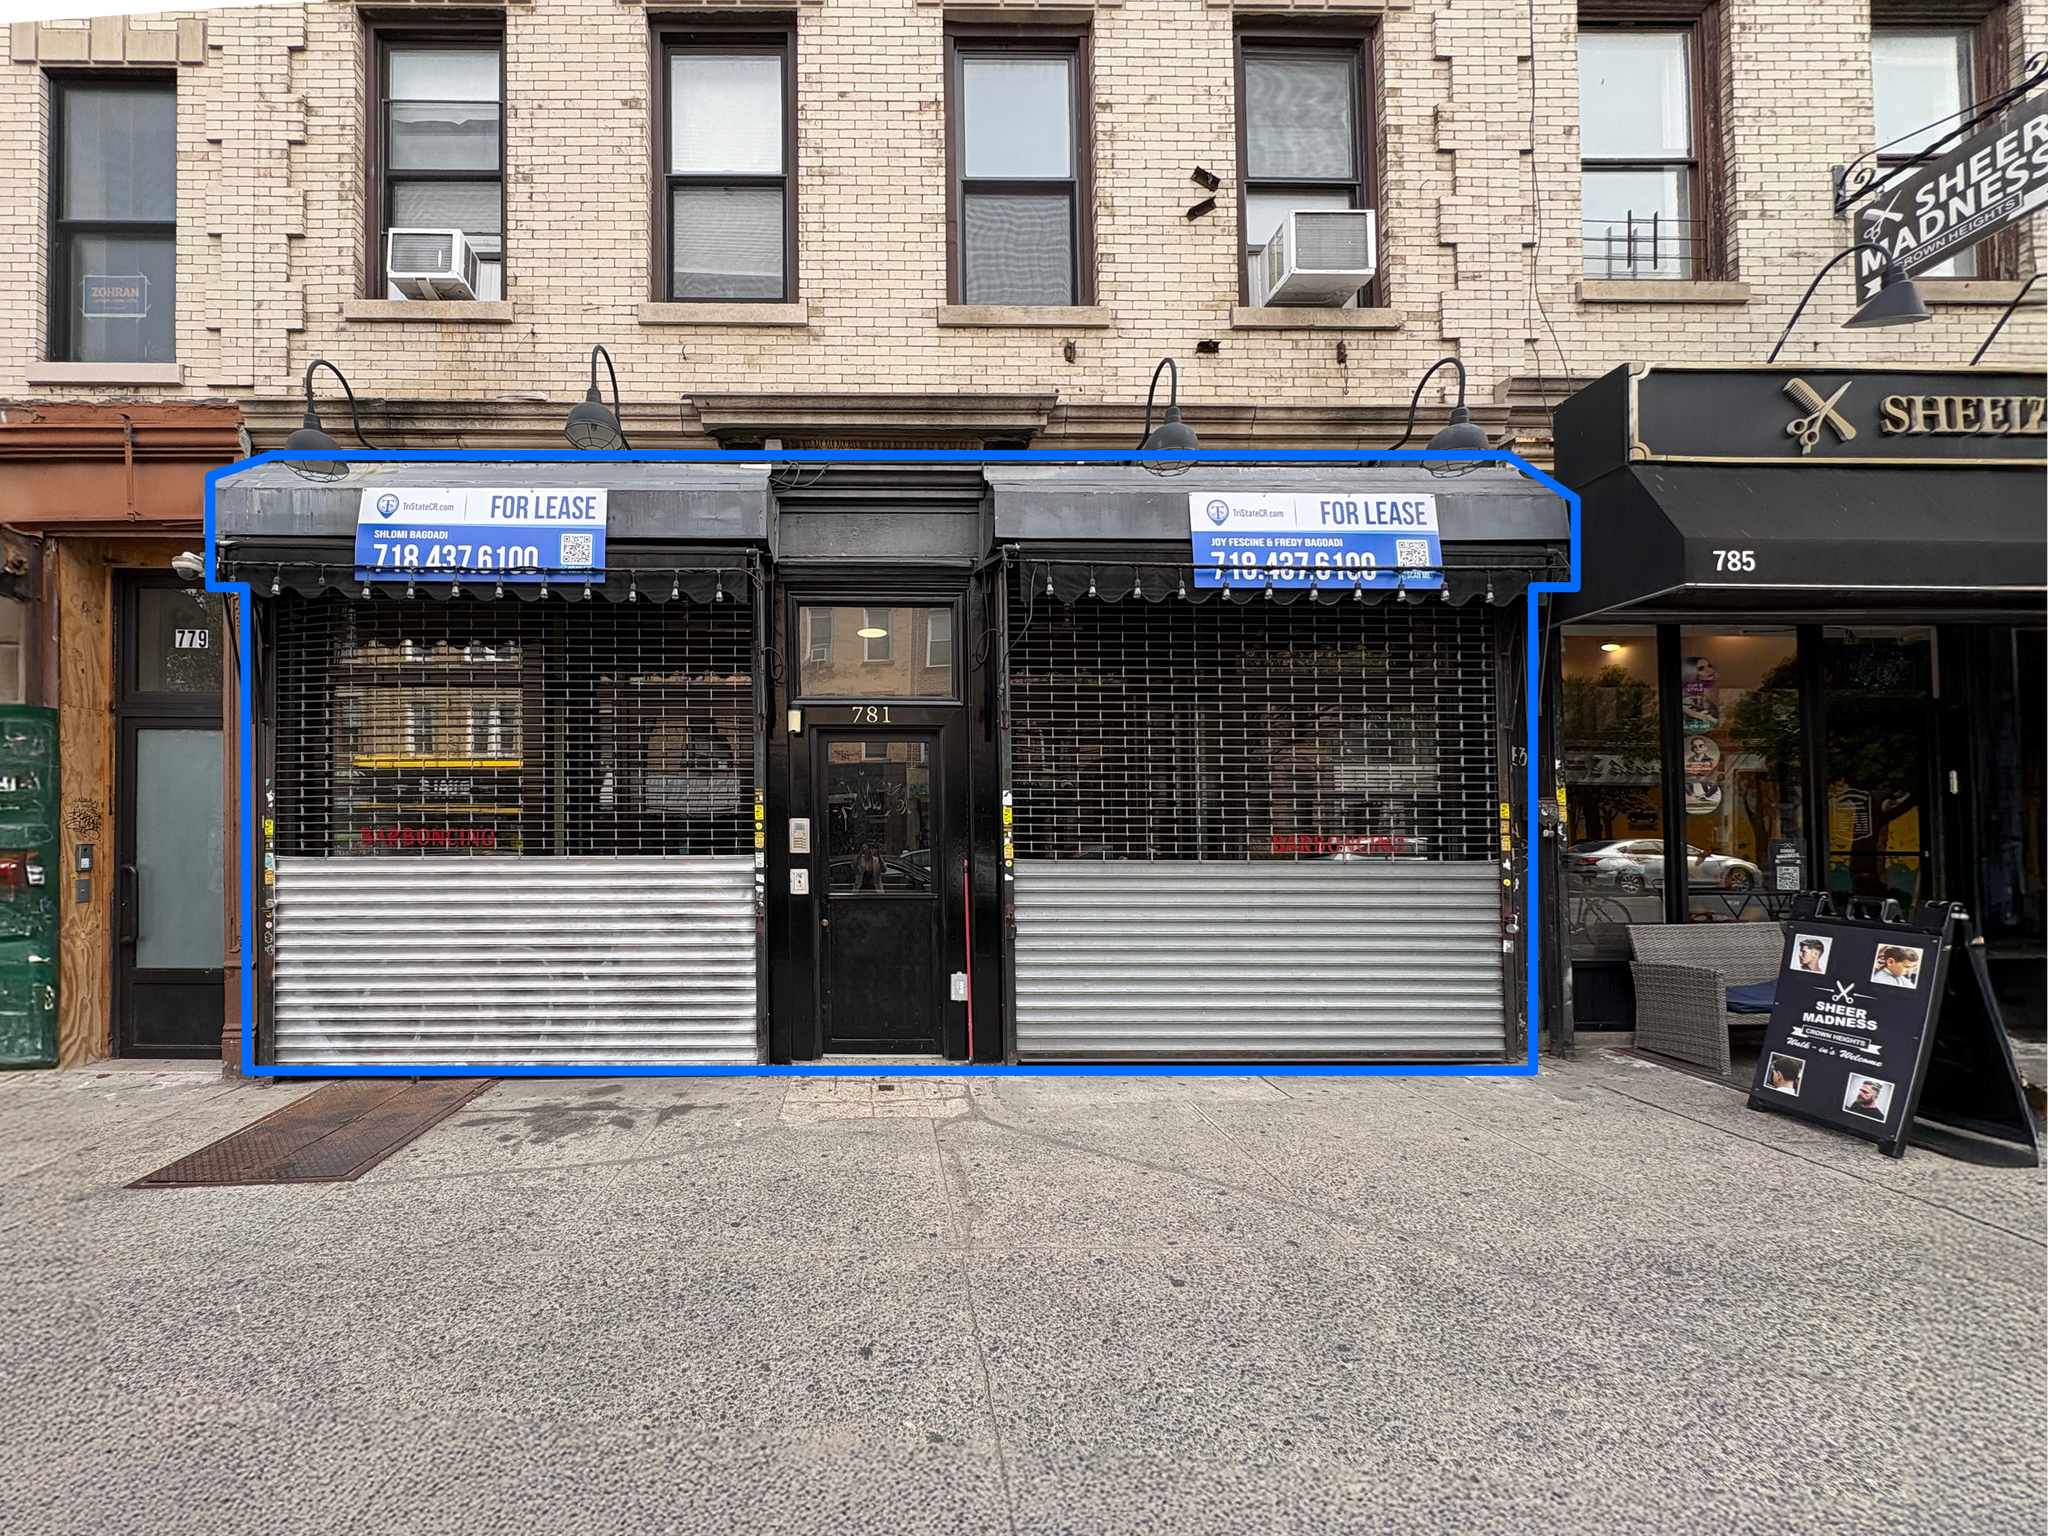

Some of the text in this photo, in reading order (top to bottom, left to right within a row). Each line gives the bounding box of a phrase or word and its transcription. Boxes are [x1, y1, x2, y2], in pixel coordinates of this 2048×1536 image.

[1915, 114, 2048, 217] SHEER
[1861, 141, 2048, 277] MADNESS
[1949, 199, 2016, 240] HEIGHTS
[91, 287, 139, 297] ZOHRAN
[403, 502, 454, 511] TriStateCR.com
[490, 495, 529, 519] FOR
[534, 495, 597, 520] LEASE
[1233, 508, 1284, 518] TriStateCR.com
[1320, 501, 1359, 525] FOR
[1364, 501, 1428, 525] LEASE
[373, 530, 448, 540] SHLOMI BAGDADI
[1210, 537, 1343, 548] JOY FESCINE & FREDY BAGDADI
[373, 543, 539, 574] 718.437.6100
[1210, 551, 1377, 581] 718.437.6100
[1712, 550, 1756, 572] 785
[177, 630, 207, 648] 779
[851, 705, 892, 724] 781
[360, 827, 495, 846] BARBONCINO
[1272, 835, 1405, 853] BARBONCINO
[1815, 1001, 1867, 1019] SHEER
[1802, 1012, 1878, 1031] MADNESS
[1805, 1028, 1866, 1047] CROWN HEIGHTS
[1786, 1037, 1811, 1049] Walk
[1839, 1050, 1883, 1067] Welcome
